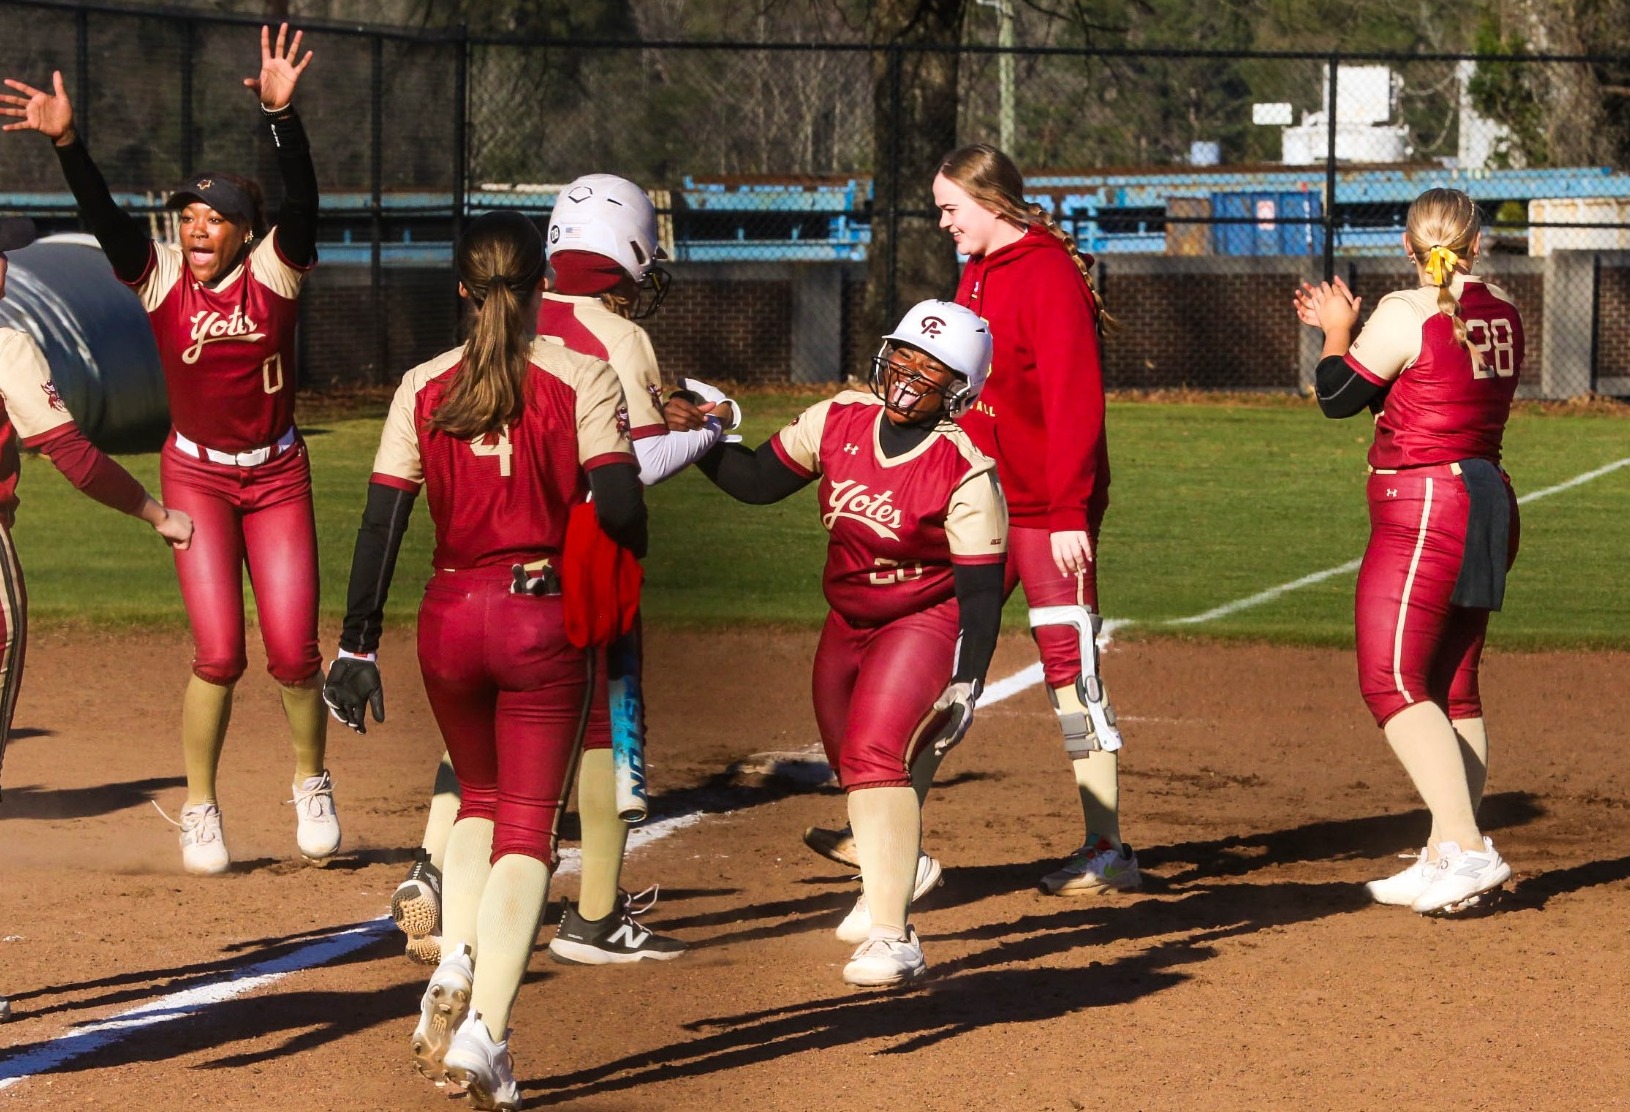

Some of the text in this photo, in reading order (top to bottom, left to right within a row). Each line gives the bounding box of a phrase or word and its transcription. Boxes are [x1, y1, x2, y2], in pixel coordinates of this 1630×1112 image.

[263, 352, 283, 394] 0
[1465, 318, 1514, 379] 28
[970, 400, 996, 417] ALL
[470, 423, 513, 477] 4
[823, 479, 901, 542] Yotes
